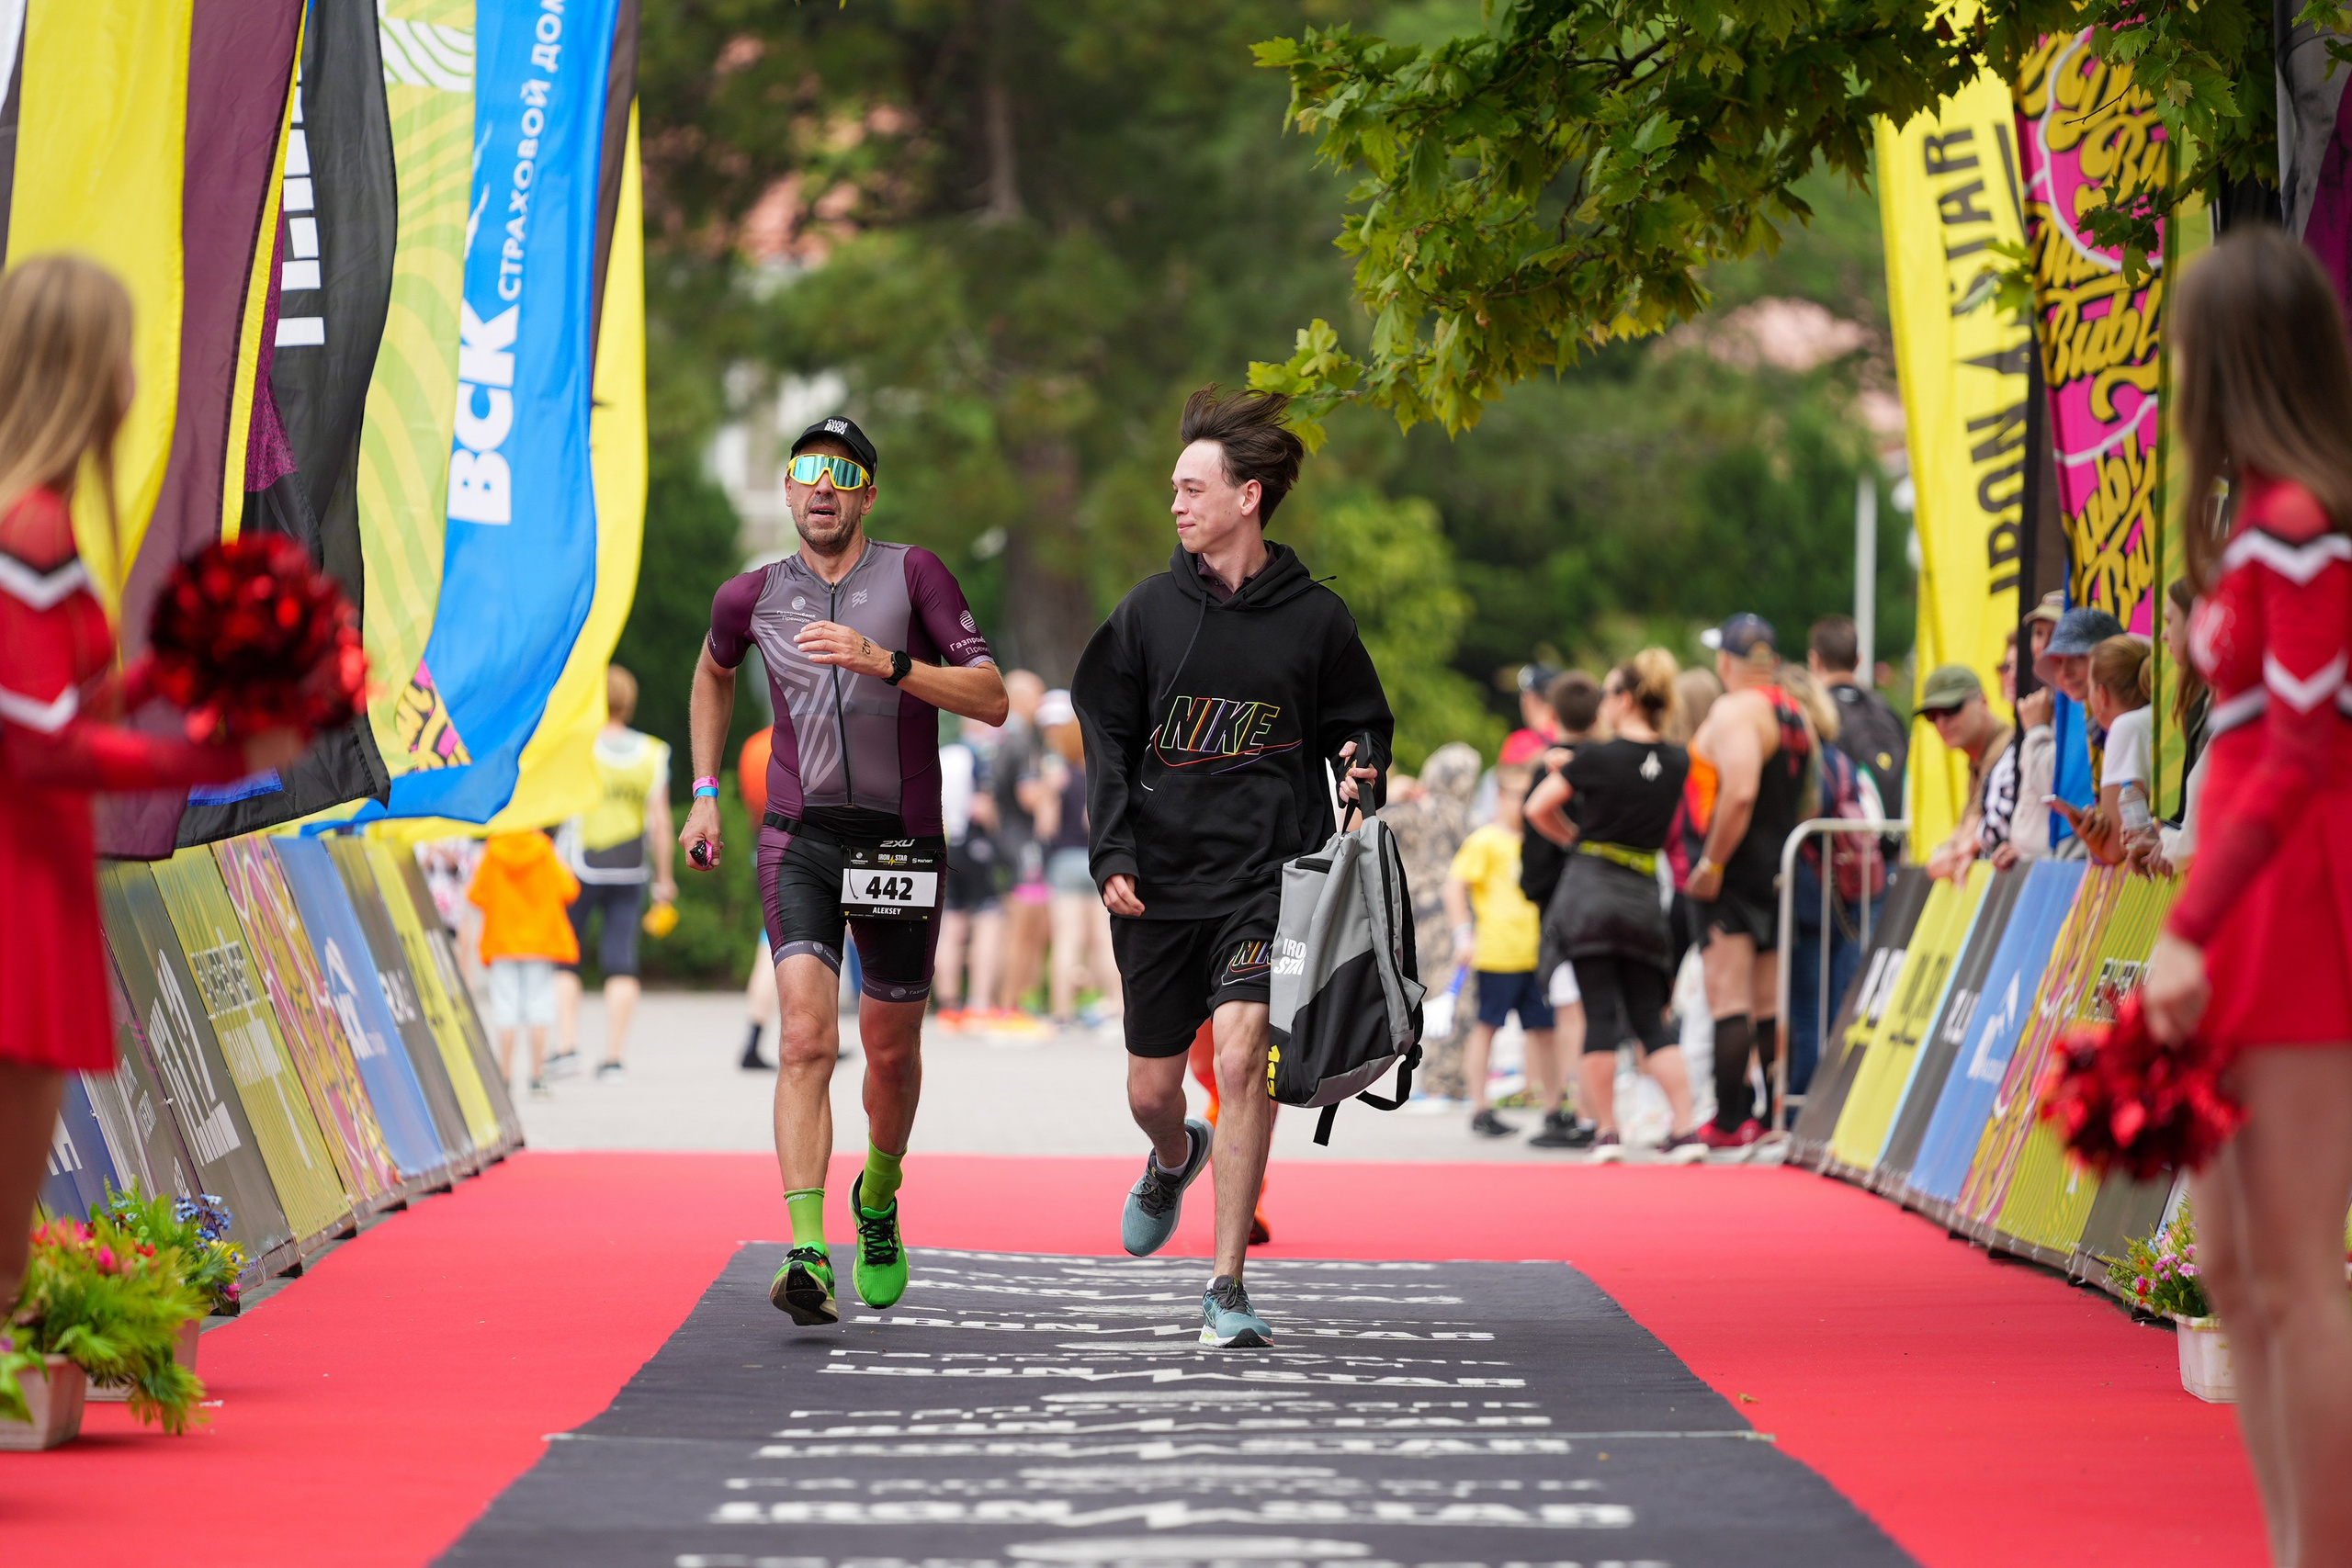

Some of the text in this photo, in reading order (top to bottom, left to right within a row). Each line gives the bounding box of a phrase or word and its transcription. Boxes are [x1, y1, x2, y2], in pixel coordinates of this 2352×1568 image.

[498, 79, 551, 301] СТРАХОВОЙ
[447, 304, 520, 525] ВСК
[1159, 695, 1281, 756] NIKE
[879, 839, 916, 848] 2XU
[865, 875, 913, 901] 442
[872, 907, 901, 916] ALEKSEY
[1232, 940, 1273, 966] NIK
[1282, 938, 1307, 959] IRO
